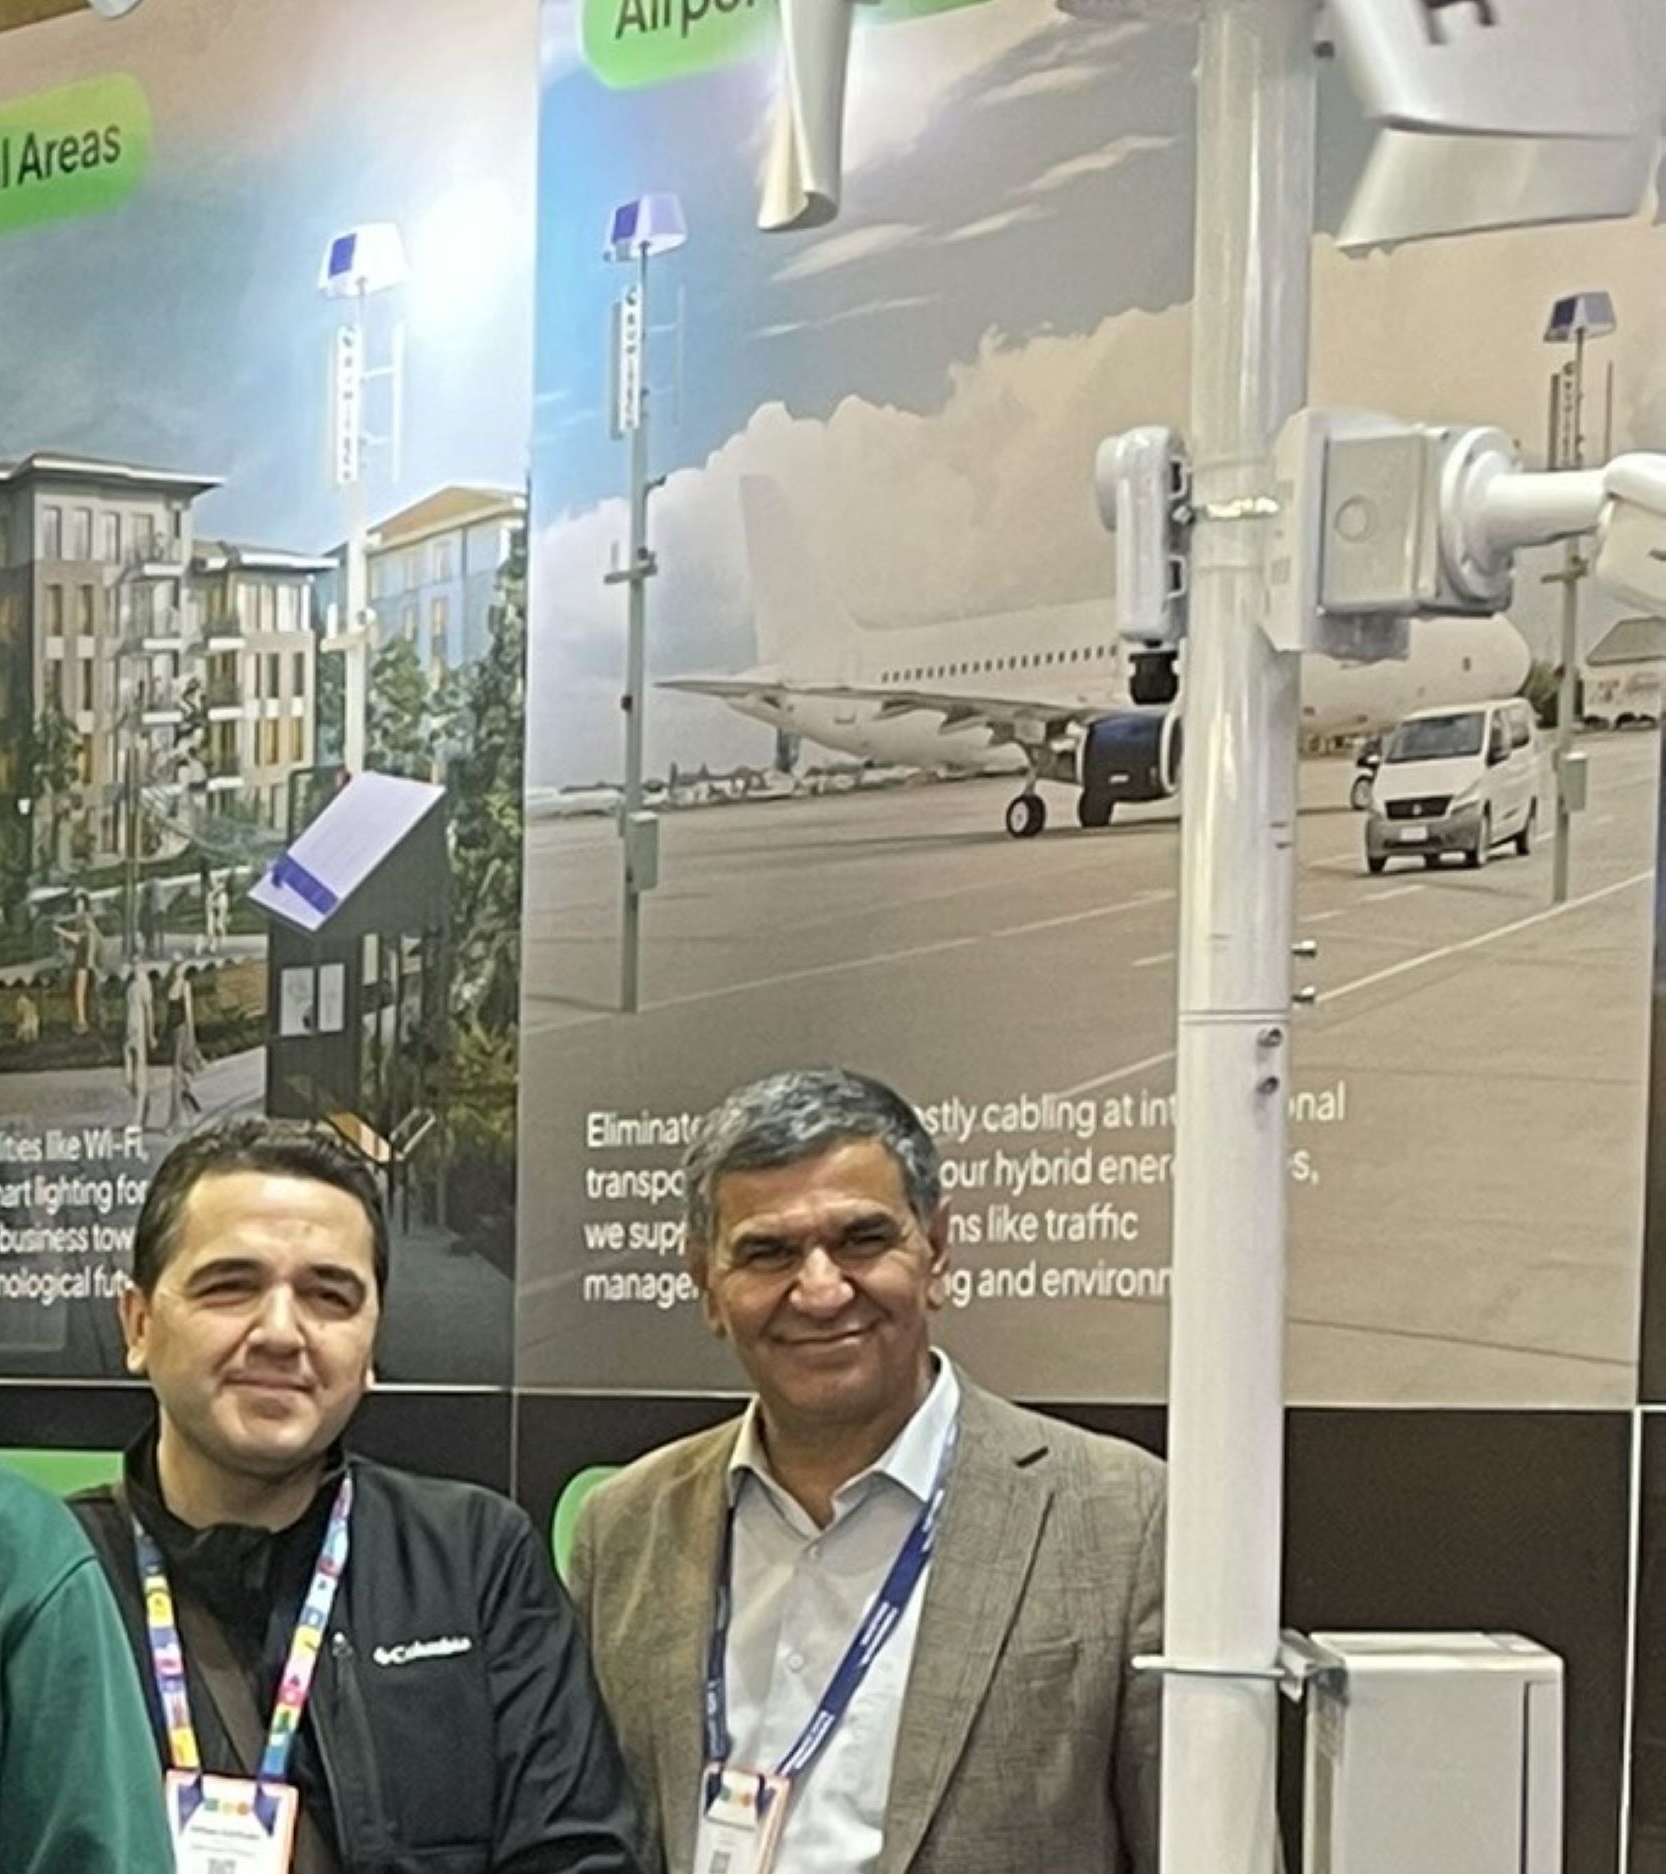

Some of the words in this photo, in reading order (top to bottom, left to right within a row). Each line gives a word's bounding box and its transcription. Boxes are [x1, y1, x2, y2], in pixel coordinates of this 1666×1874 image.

[16, 123, 122, 187] Areas
[914, 1095, 978, 1143] stly
[982, 1091, 1097, 1138] cabling
[1103, 1093, 1134, 1128] at
[33, 1174, 113, 1214] lighting
[585, 1167, 686, 1205] transpo
[939, 1158, 989, 1188] our
[994, 1147, 1093, 1197] hybrid
[1099, 1152, 1176, 1185] ener
[92, 1223, 136, 1252] tow
[584, 1221, 626, 1250] we
[987, 1203, 1039, 1242] like
[1044, 1202, 1139, 1241] traffic
[583, 1272, 699, 1310] manage
[977, 1258, 1036, 1299] and
